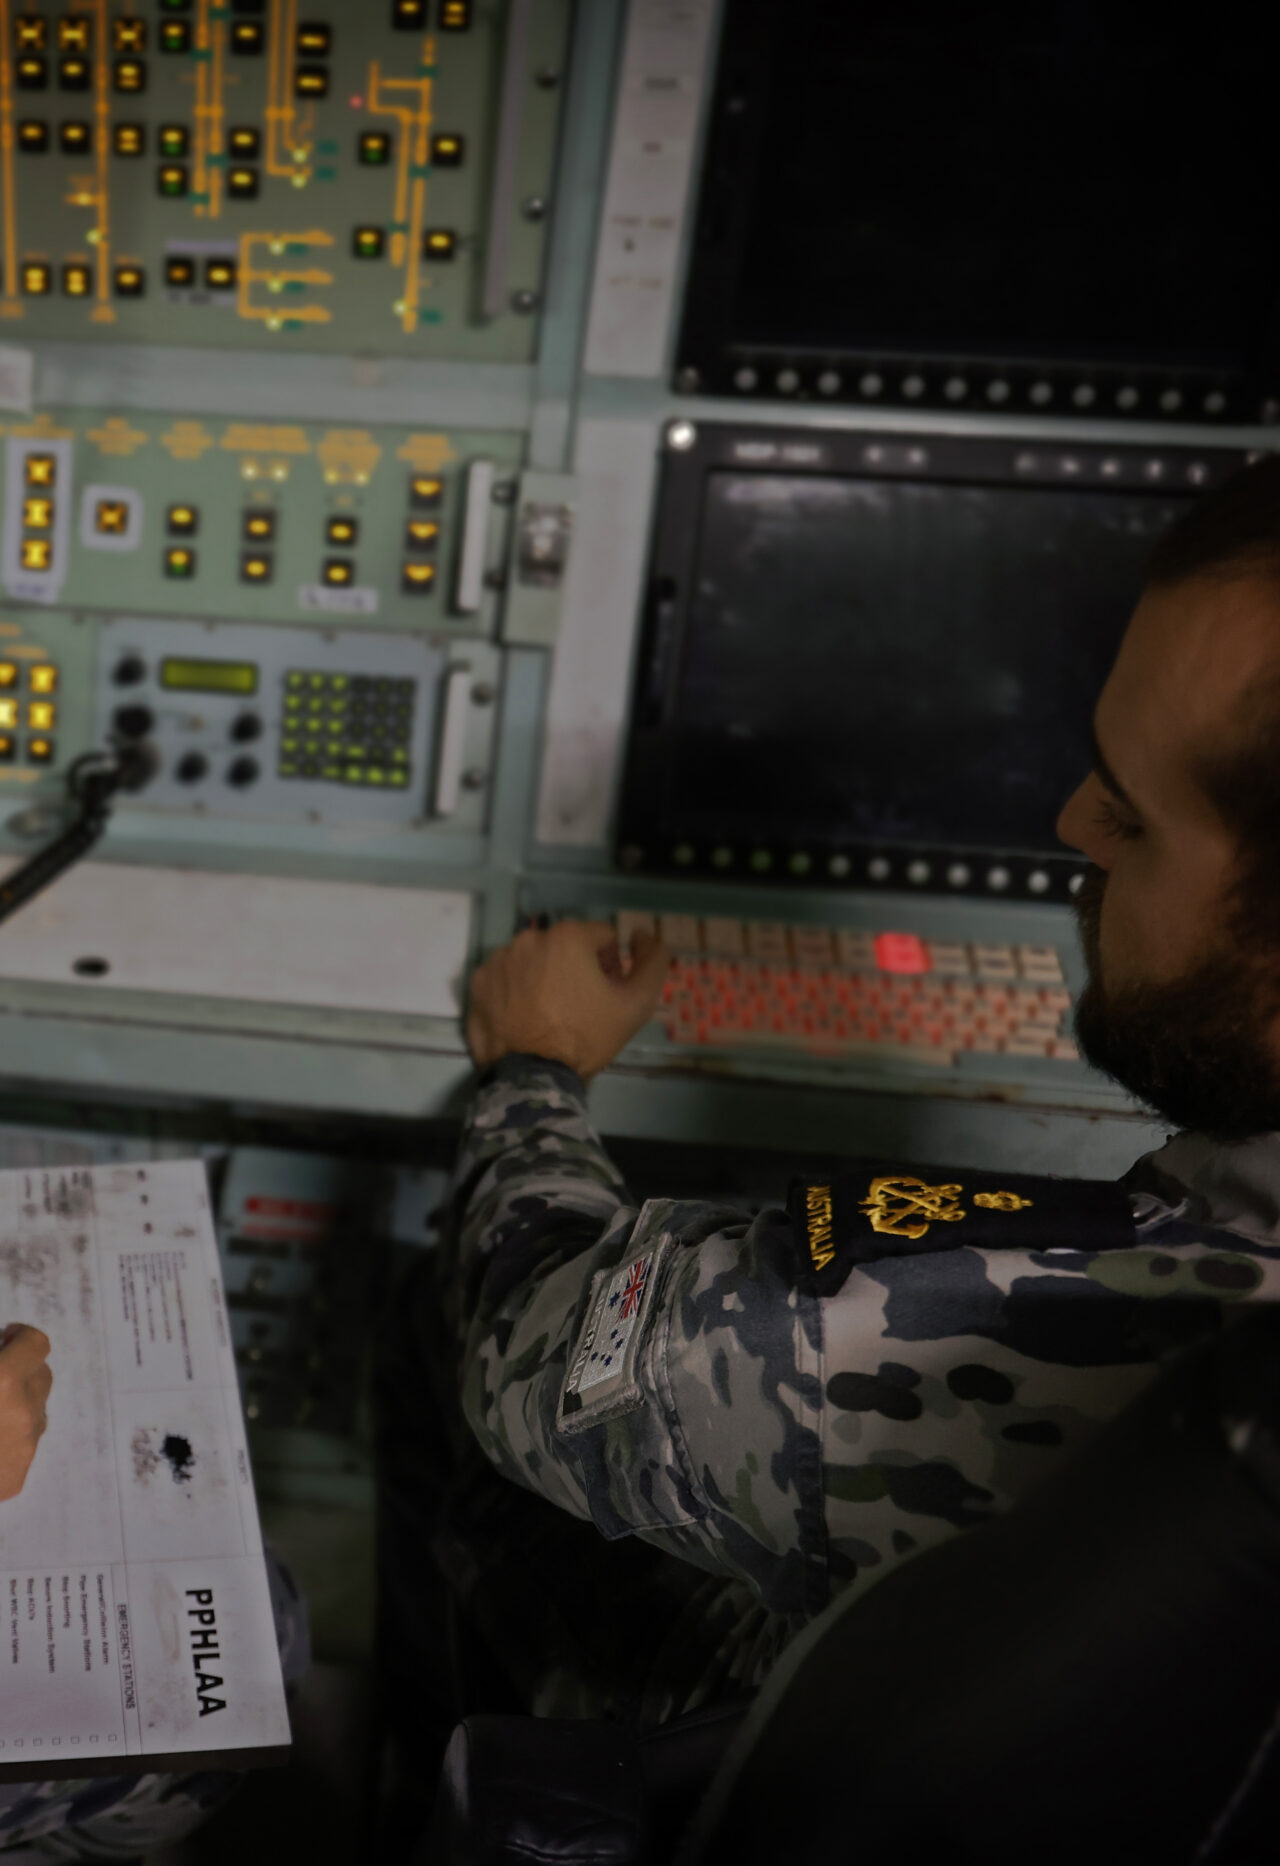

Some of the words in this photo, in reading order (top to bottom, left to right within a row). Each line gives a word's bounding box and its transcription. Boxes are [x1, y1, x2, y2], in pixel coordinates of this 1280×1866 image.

[116, 1604, 131, 1661] EMERGENCY
[185, 1588, 227, 1717] PPHLAA
[46, 1644, 56, 1674] System
[122, 1664, 136, 1710] STATIONS
